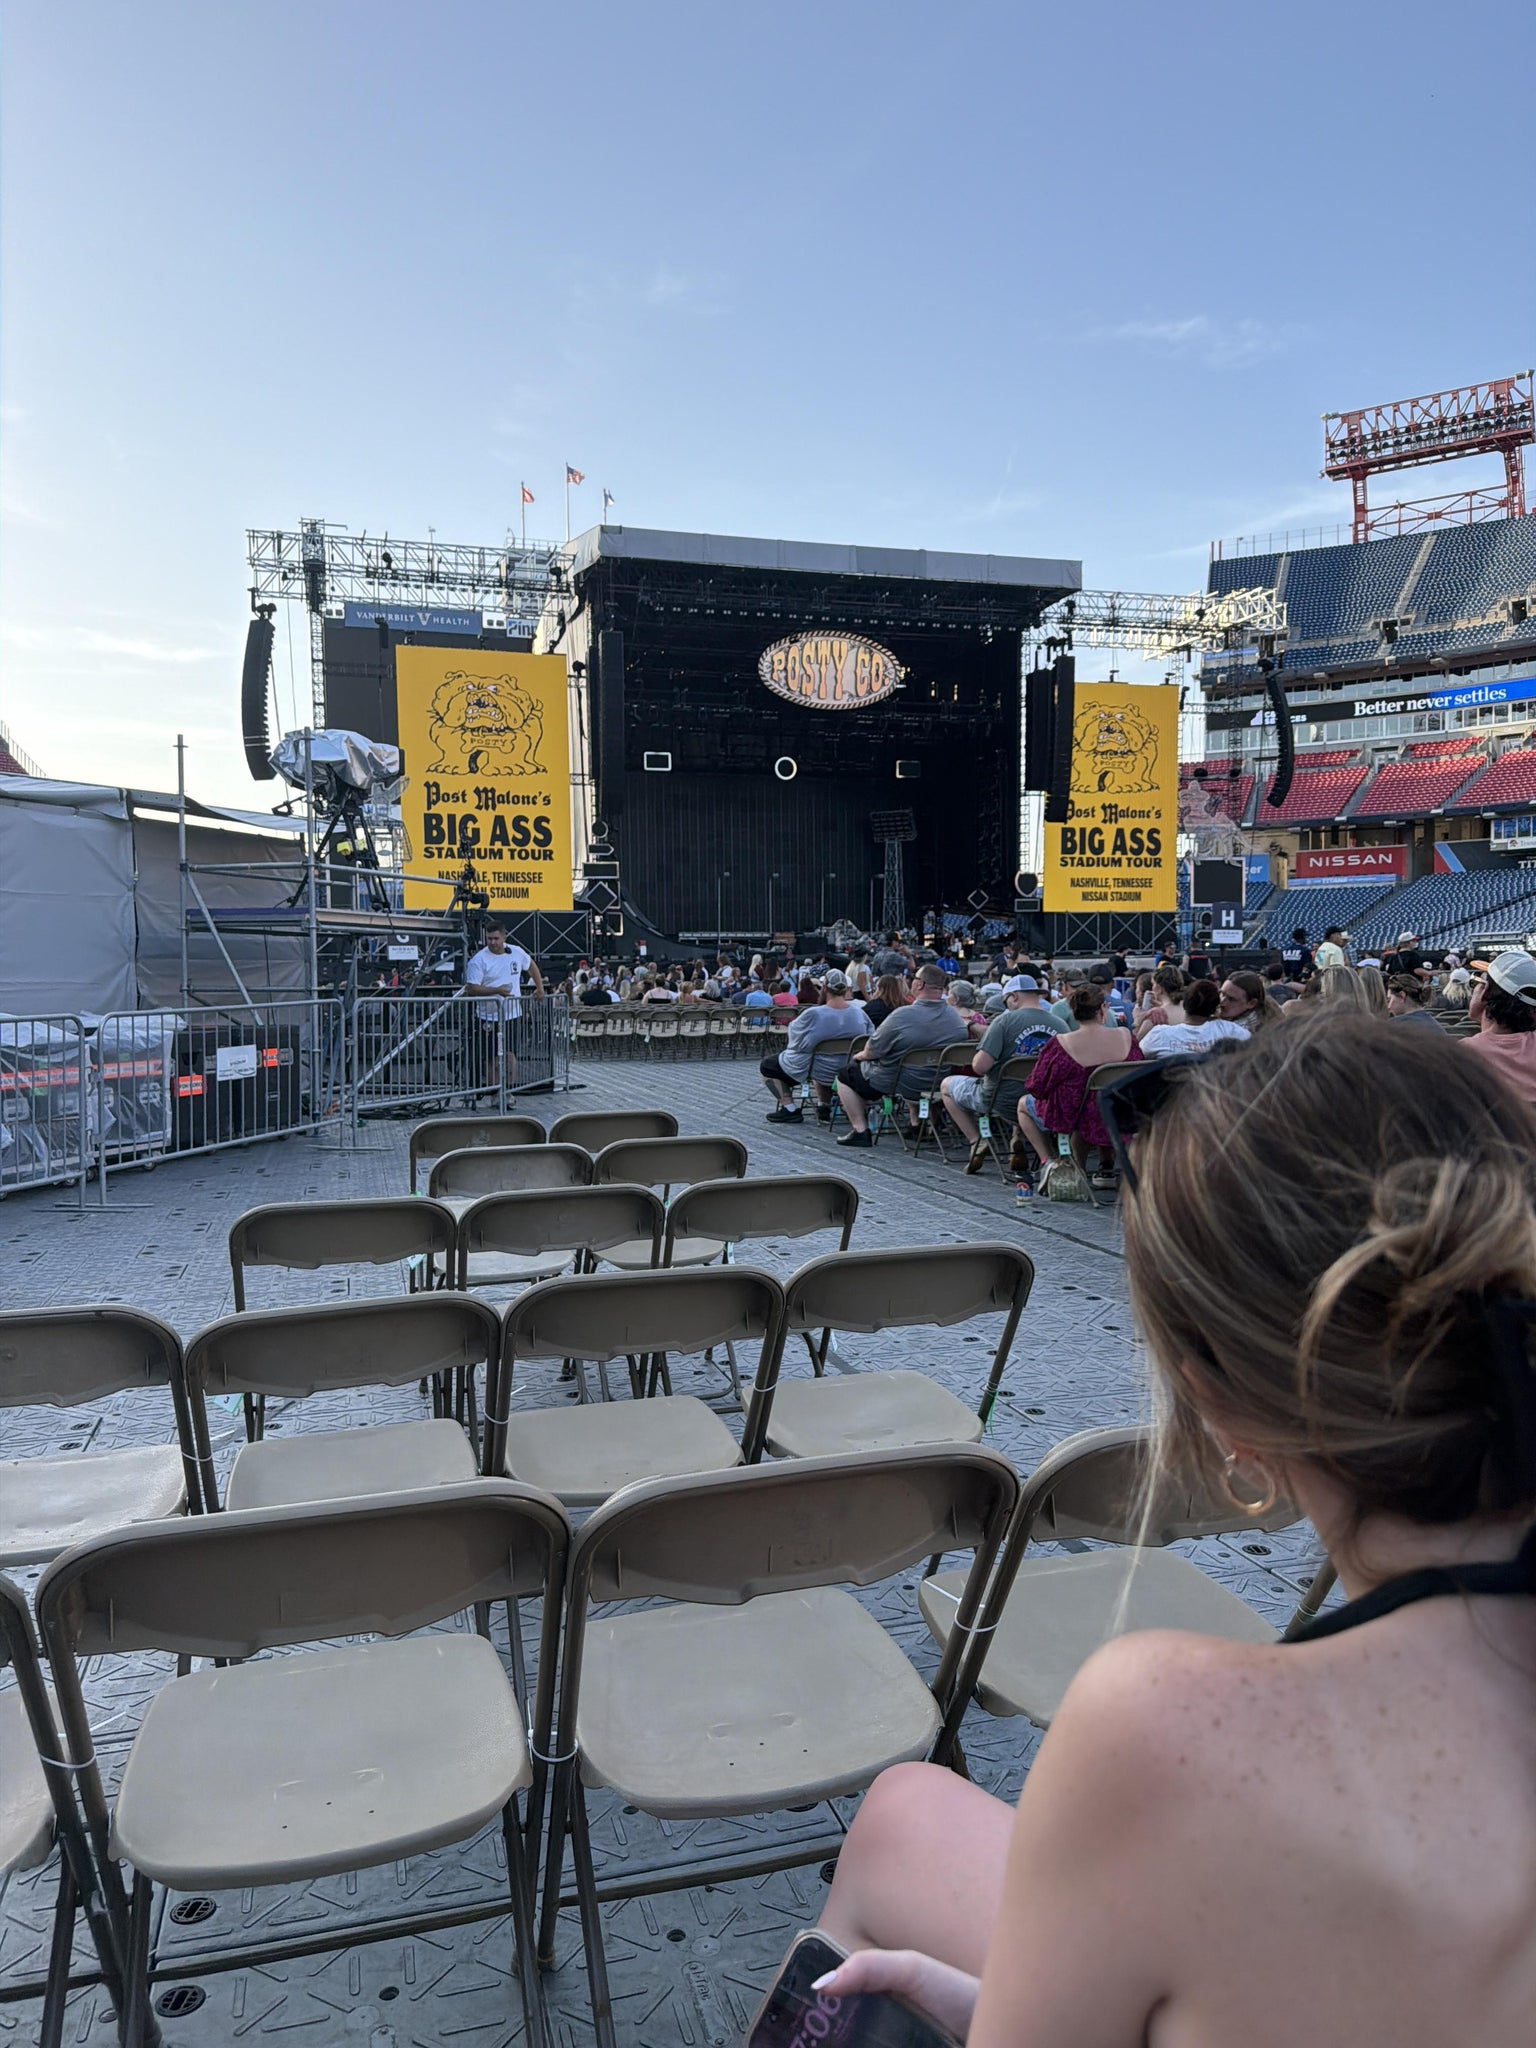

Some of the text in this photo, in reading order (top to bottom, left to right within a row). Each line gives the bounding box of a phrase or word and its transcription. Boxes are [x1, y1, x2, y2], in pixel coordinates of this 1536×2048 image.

[433, 616, 470, 626] HEALTH
[772, 640, 890, 700] POSTY CO.
[1354, 686, 1507, 717] Better never settles
[470, 738, 508, 746] POSTY
[423, 781, 551, 812] Post Malone's
[1101, 803, 1162, 824] Malone's
[423, 813, 553, 848] BIG ASS
[1061, 827, 1162, 856] BIG ASS
[507, 849, 554, 861] TOUR
[1309, 853, 1393, 868] NISSAN
[1060, 857, 1162, 868] STADIUM TOUR
[492, 871, 543, 884] TENNESSEE
[1070, 877, 1153, 890] NASHVILLE, TENNESSEE
[490, 887, 529, 899] STADIUM
[1081, 891, 1141, 901] NISSAN STADIUM
[1221, 909, 1235, 928] H
